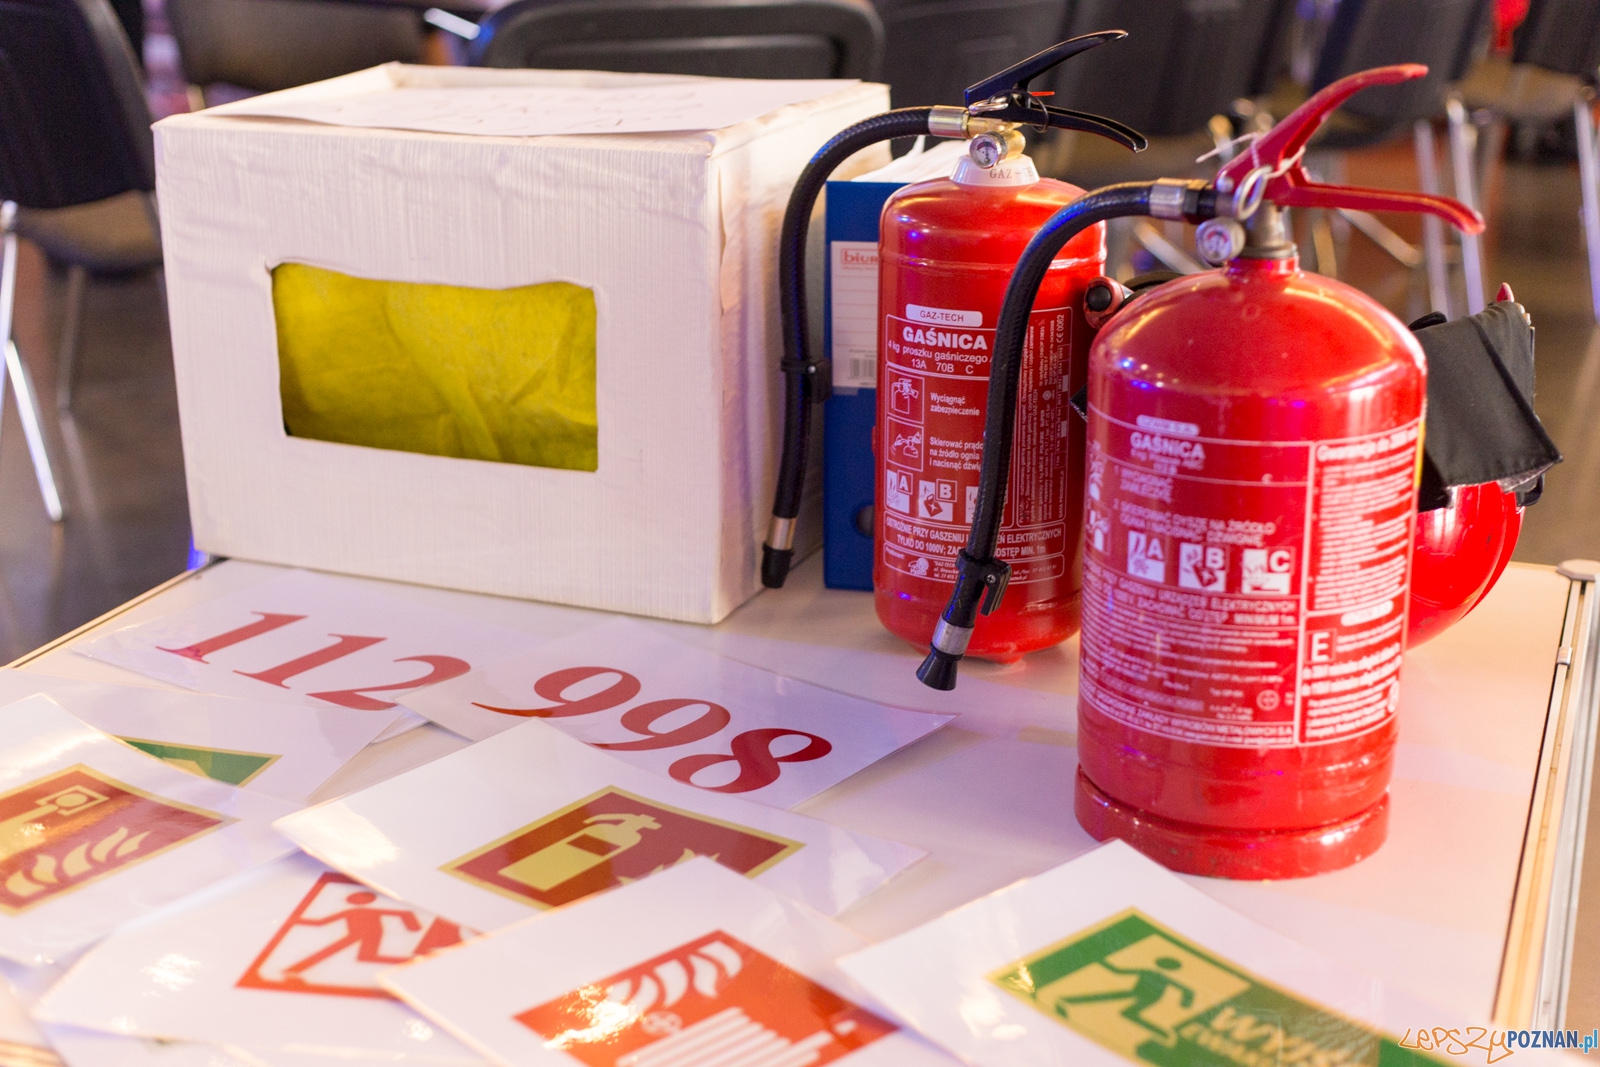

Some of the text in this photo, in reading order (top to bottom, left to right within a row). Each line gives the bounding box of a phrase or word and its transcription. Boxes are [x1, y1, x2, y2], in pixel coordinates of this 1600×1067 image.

[919, 309, 964, 323] GAZ-TECH
[902, 326, 988, 351] GAŚNICA
[888, 340, 893, 348] 4
[892, 341, 900, 353] kg
[902, 346, 932, 358] proszku
[934, 351, 988, 364] gaśniczego
[911, 358, 974, 375] 13A 70B C
[930, 391, 966, 405] Wyciągnąć
[930, 404, 980, 416] zabezpieczenie
[929, 436, 963, 449] Skierować
[1129, 432, 1206, 460] GAŚNICA
[938, 448, 959, 458] źródło
[960, 451, 980, 461] ognia
[933, 459, 962, 471] nacisnąć
[899, 474, 908, 491] A
[939, 484, 951, 499] B
[913, 526, 929, 538] PRZY
[929, 529, 965, 543] GASZENIU
[1006, 527, 1062, 544] ELEKTRYCZNYCH
[1209, 518, 1225, 531] NA
[1226, 518, 1277, 536] ŹRÓDŁO
[897, 534, 914, 548] TYLKO
[915, 540, 925, 550] DO
[1147, 537, 1165, 560] A
[1205, 547, 1225, 569] B
[1269, 550, 1292, 573] C
[1311, 631, 1330, 662] E
[156, 611, 472, 712] 112
[471, 665, 832, 795] 998
